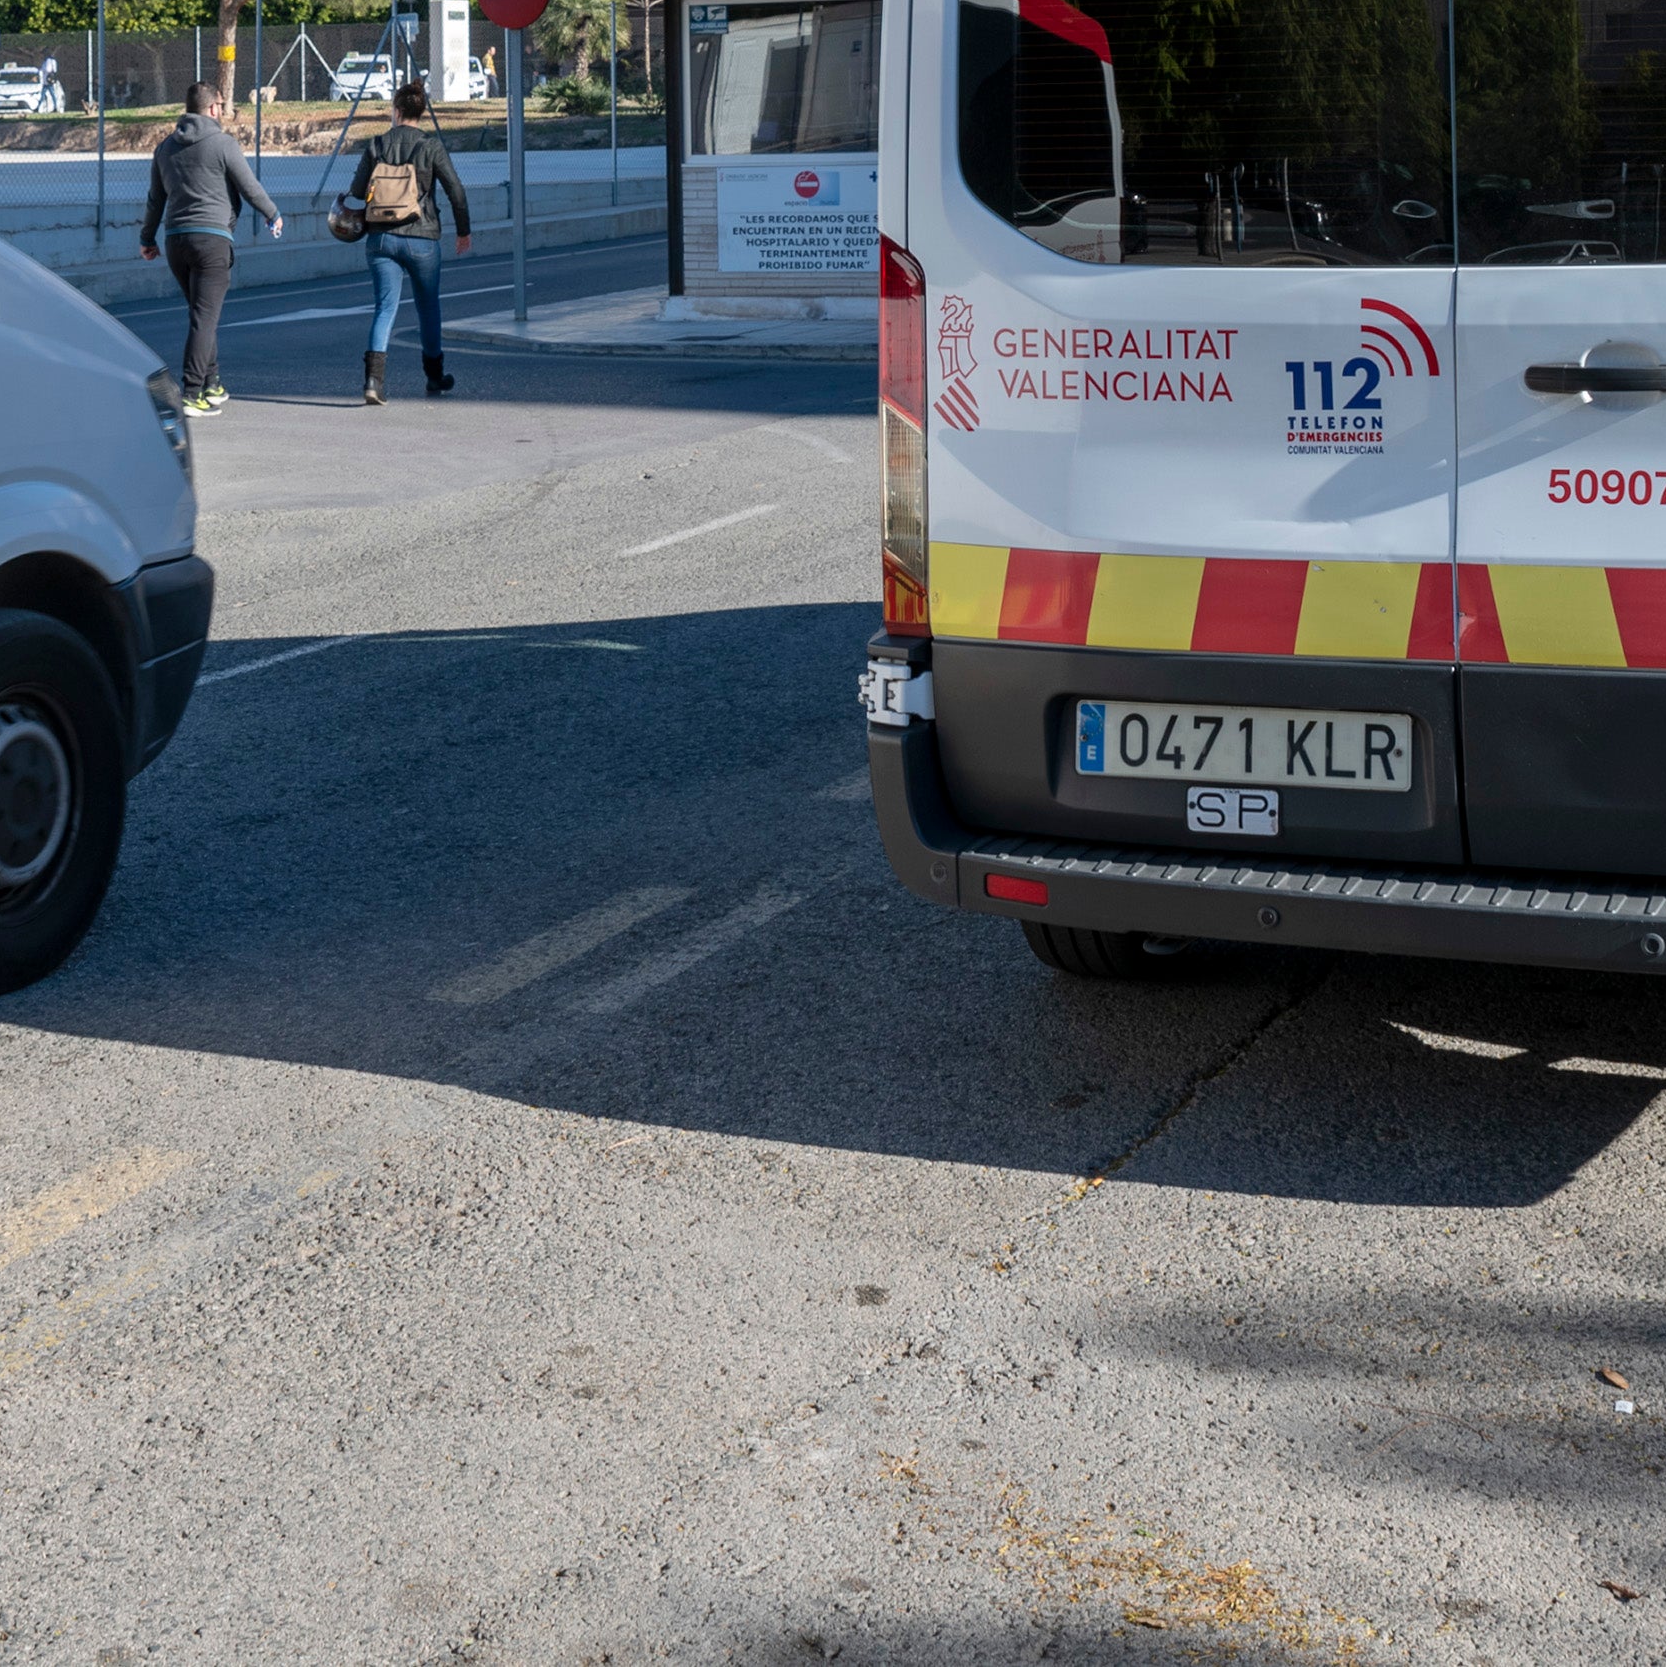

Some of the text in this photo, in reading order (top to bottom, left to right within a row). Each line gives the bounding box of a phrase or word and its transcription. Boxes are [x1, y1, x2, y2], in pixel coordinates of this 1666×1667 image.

[768, 214, 844, 223] RECORDAMOS
[847, 214, 871, 224] QUE
[732, 226, 805, 235] ENCUENTRAN
[809, 226, 823, 235] EN
[827, 226, 842, 235] UN
[746, 238, 830, 246] HOSPITALARIO
[833, 238, 840, 246] Y
[759, 249, 868, 258] TERMINANTEMENTE
[758, 261, 823, 270] PROHIBIDO
[993, 328, 1239, 360] GENERALITAT
[998, 369, 1234, 403] VALENCIANA
[1285, 356, 1382, 411] 112
[1287, 416, 1383, 430] TELEFON
[1287, 431, 1383, 442] D'EMERGENCIES
[1287, 445, 1385, 455] COMUNITAT VALENCIANA
[1086, 712, 1397, 782] E 0471 KLR
[1196, 792, 1269, 830] SP
